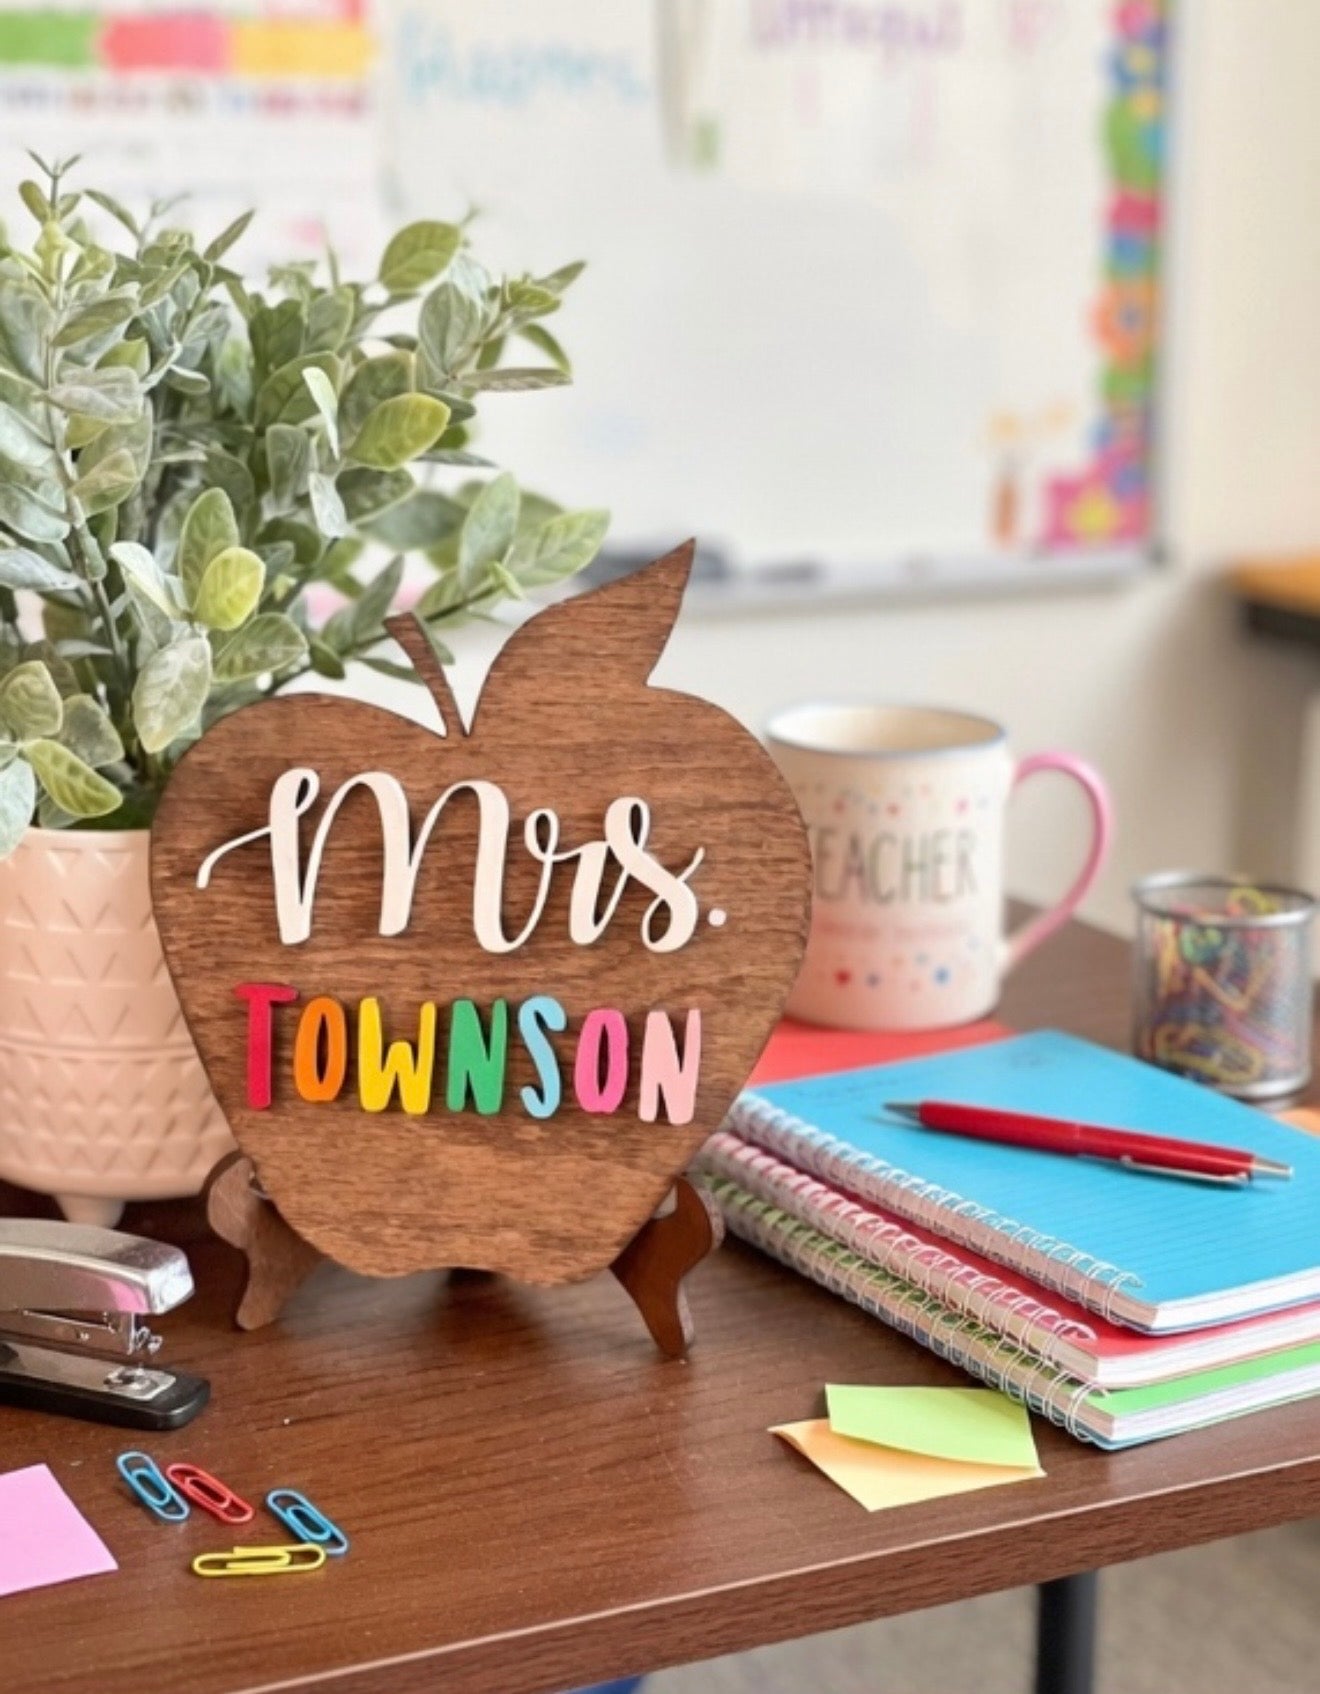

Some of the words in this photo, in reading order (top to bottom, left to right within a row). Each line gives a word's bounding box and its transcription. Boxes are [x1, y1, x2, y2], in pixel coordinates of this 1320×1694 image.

[196, 768, 727, 953] Mrs.
[808, 825, 978, 904] EACHER
[235, 983, 702, 1125] TOWNSON
